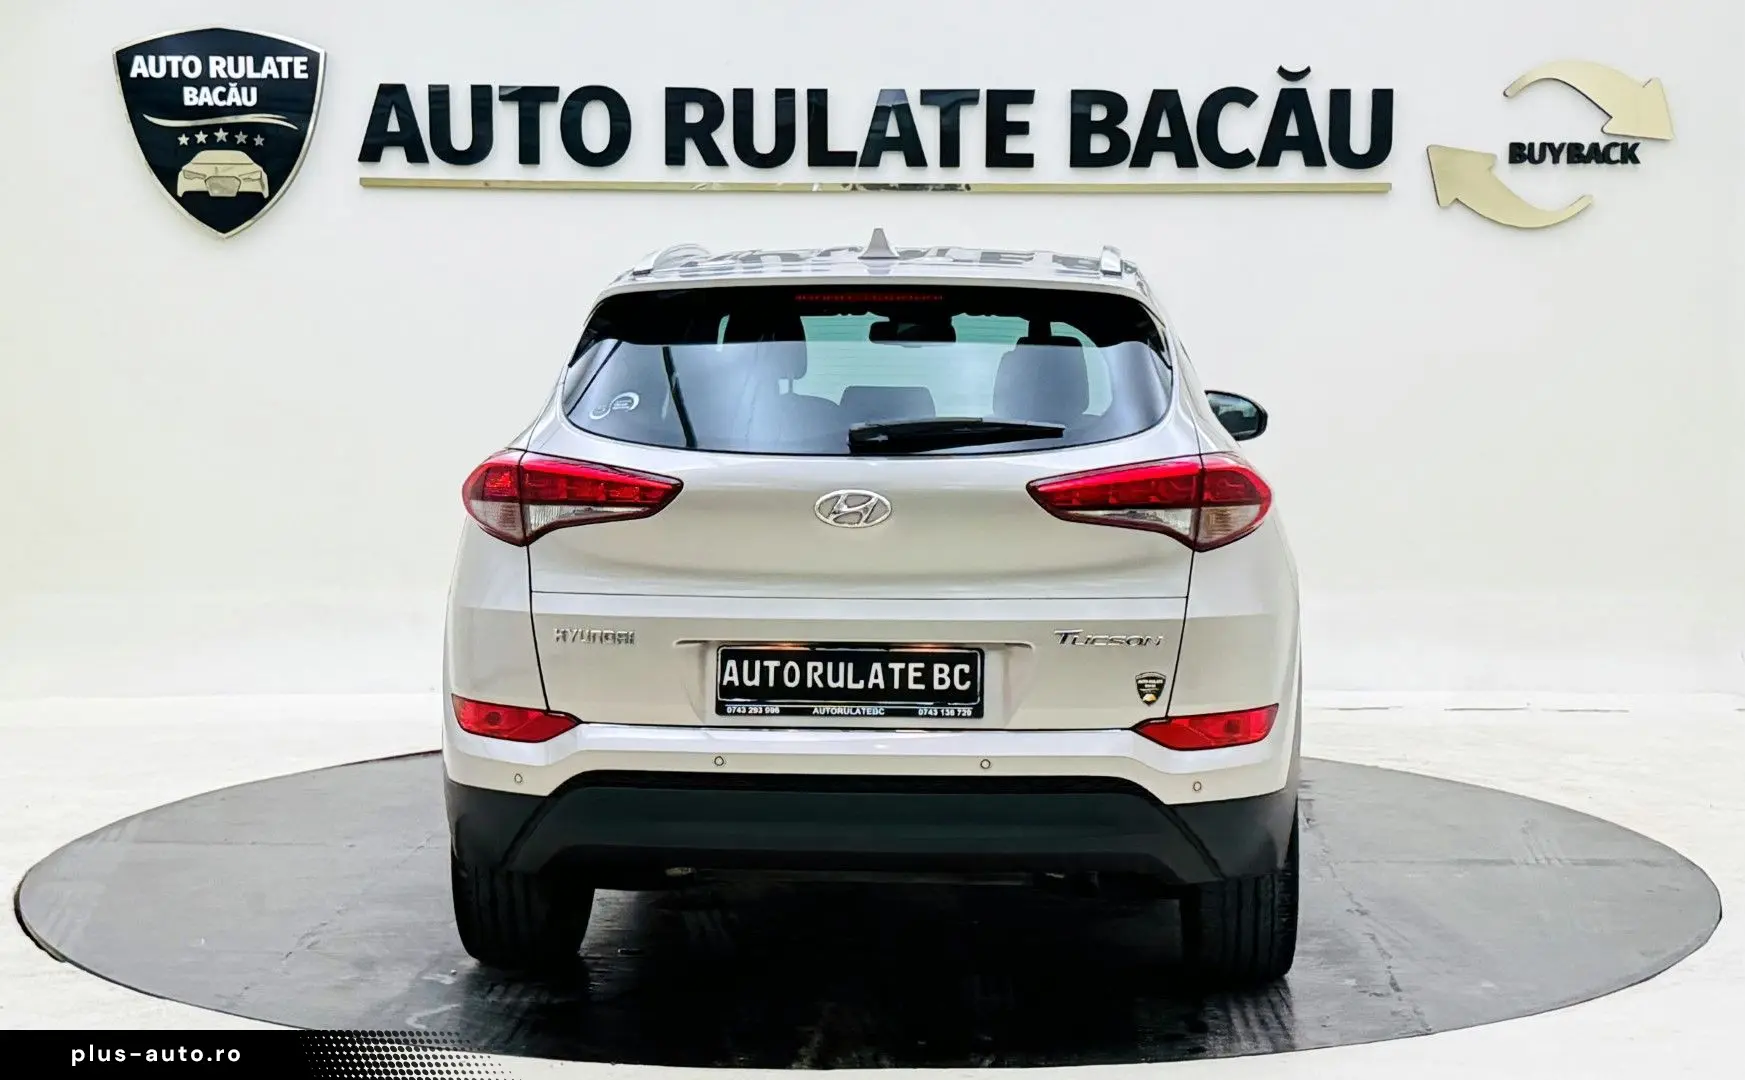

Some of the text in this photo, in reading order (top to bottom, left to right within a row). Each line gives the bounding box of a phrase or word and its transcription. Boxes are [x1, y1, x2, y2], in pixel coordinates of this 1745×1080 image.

[129, 54, 309, 80] AUTO RULATE
[182, 82, 258, 107] BACĂU
[358, 65, 1395, 171] AUTO RULATE BACĂU
[1508, 142, 1641, 165] BUYBACK
[722, 659, 971, 691] AUTO RULATE BC
